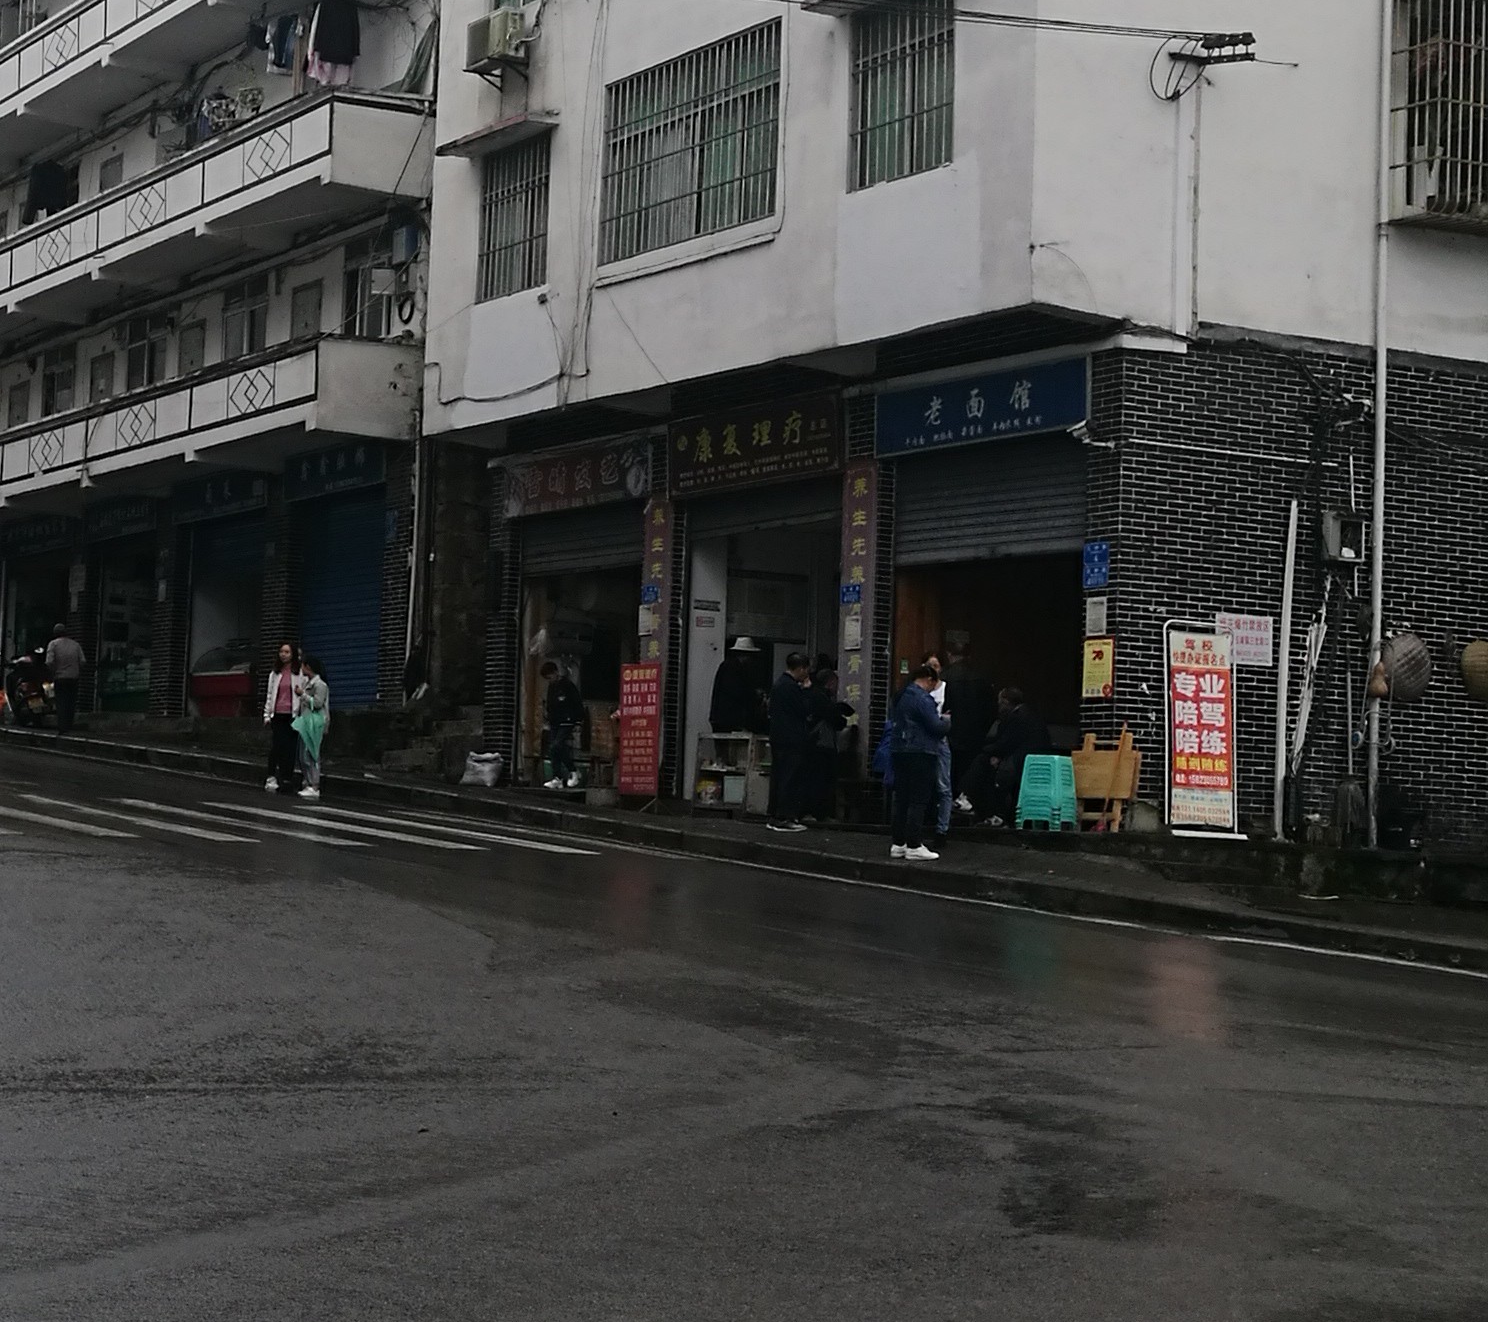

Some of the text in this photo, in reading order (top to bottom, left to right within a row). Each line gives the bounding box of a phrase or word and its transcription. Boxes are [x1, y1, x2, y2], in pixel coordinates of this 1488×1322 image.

[924, 379, 1033, 427] 老面馆
[1173, 671, 1226, 699] 专业
[1174, 699, 1226, 727] 陪驾
[1175, 727, 1228, 755] 陪练
